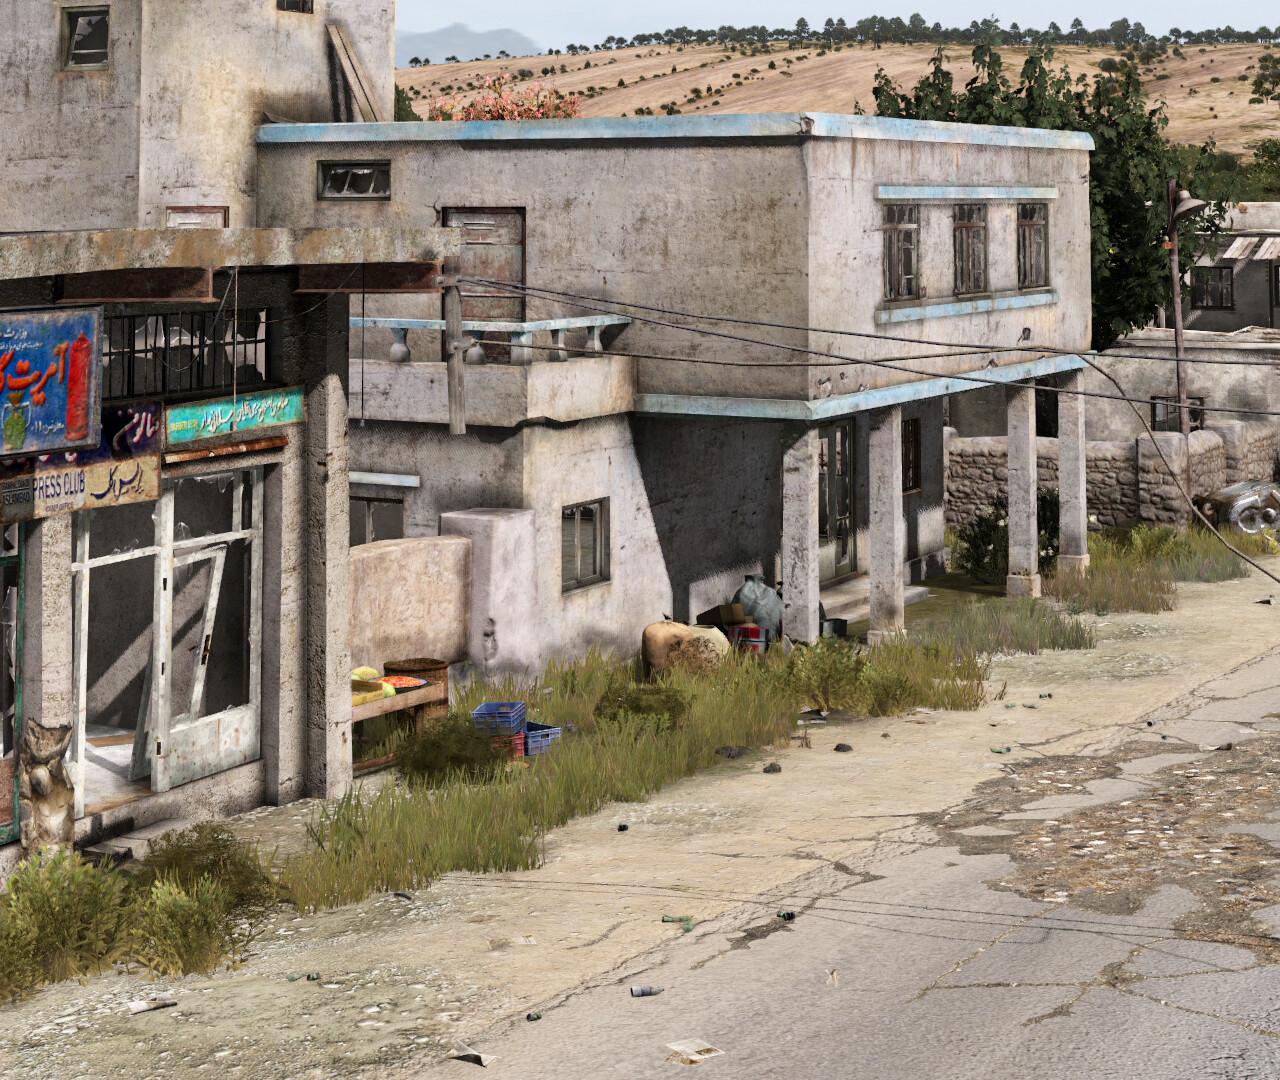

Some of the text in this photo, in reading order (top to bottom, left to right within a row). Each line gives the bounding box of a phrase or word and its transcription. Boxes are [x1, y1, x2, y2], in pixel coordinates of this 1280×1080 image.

[170, 422, 187, 432] BARBER
[33, 469, 85, 500] PRESS CLUB
